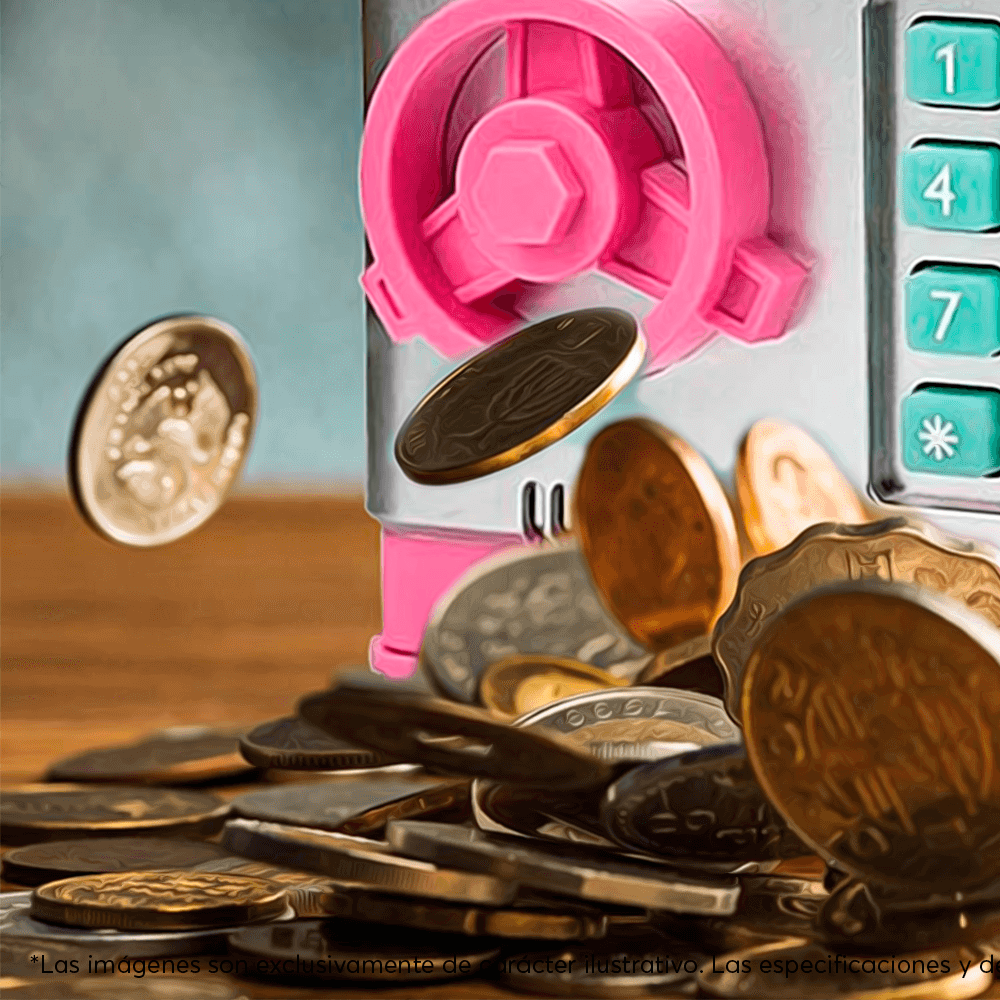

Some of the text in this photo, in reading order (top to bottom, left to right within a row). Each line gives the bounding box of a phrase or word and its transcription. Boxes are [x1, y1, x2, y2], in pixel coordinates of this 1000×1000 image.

[934, 42, 958, 95] 1
[922, 162, 956, 217] 4
[929, 290, 963, 342] 7
